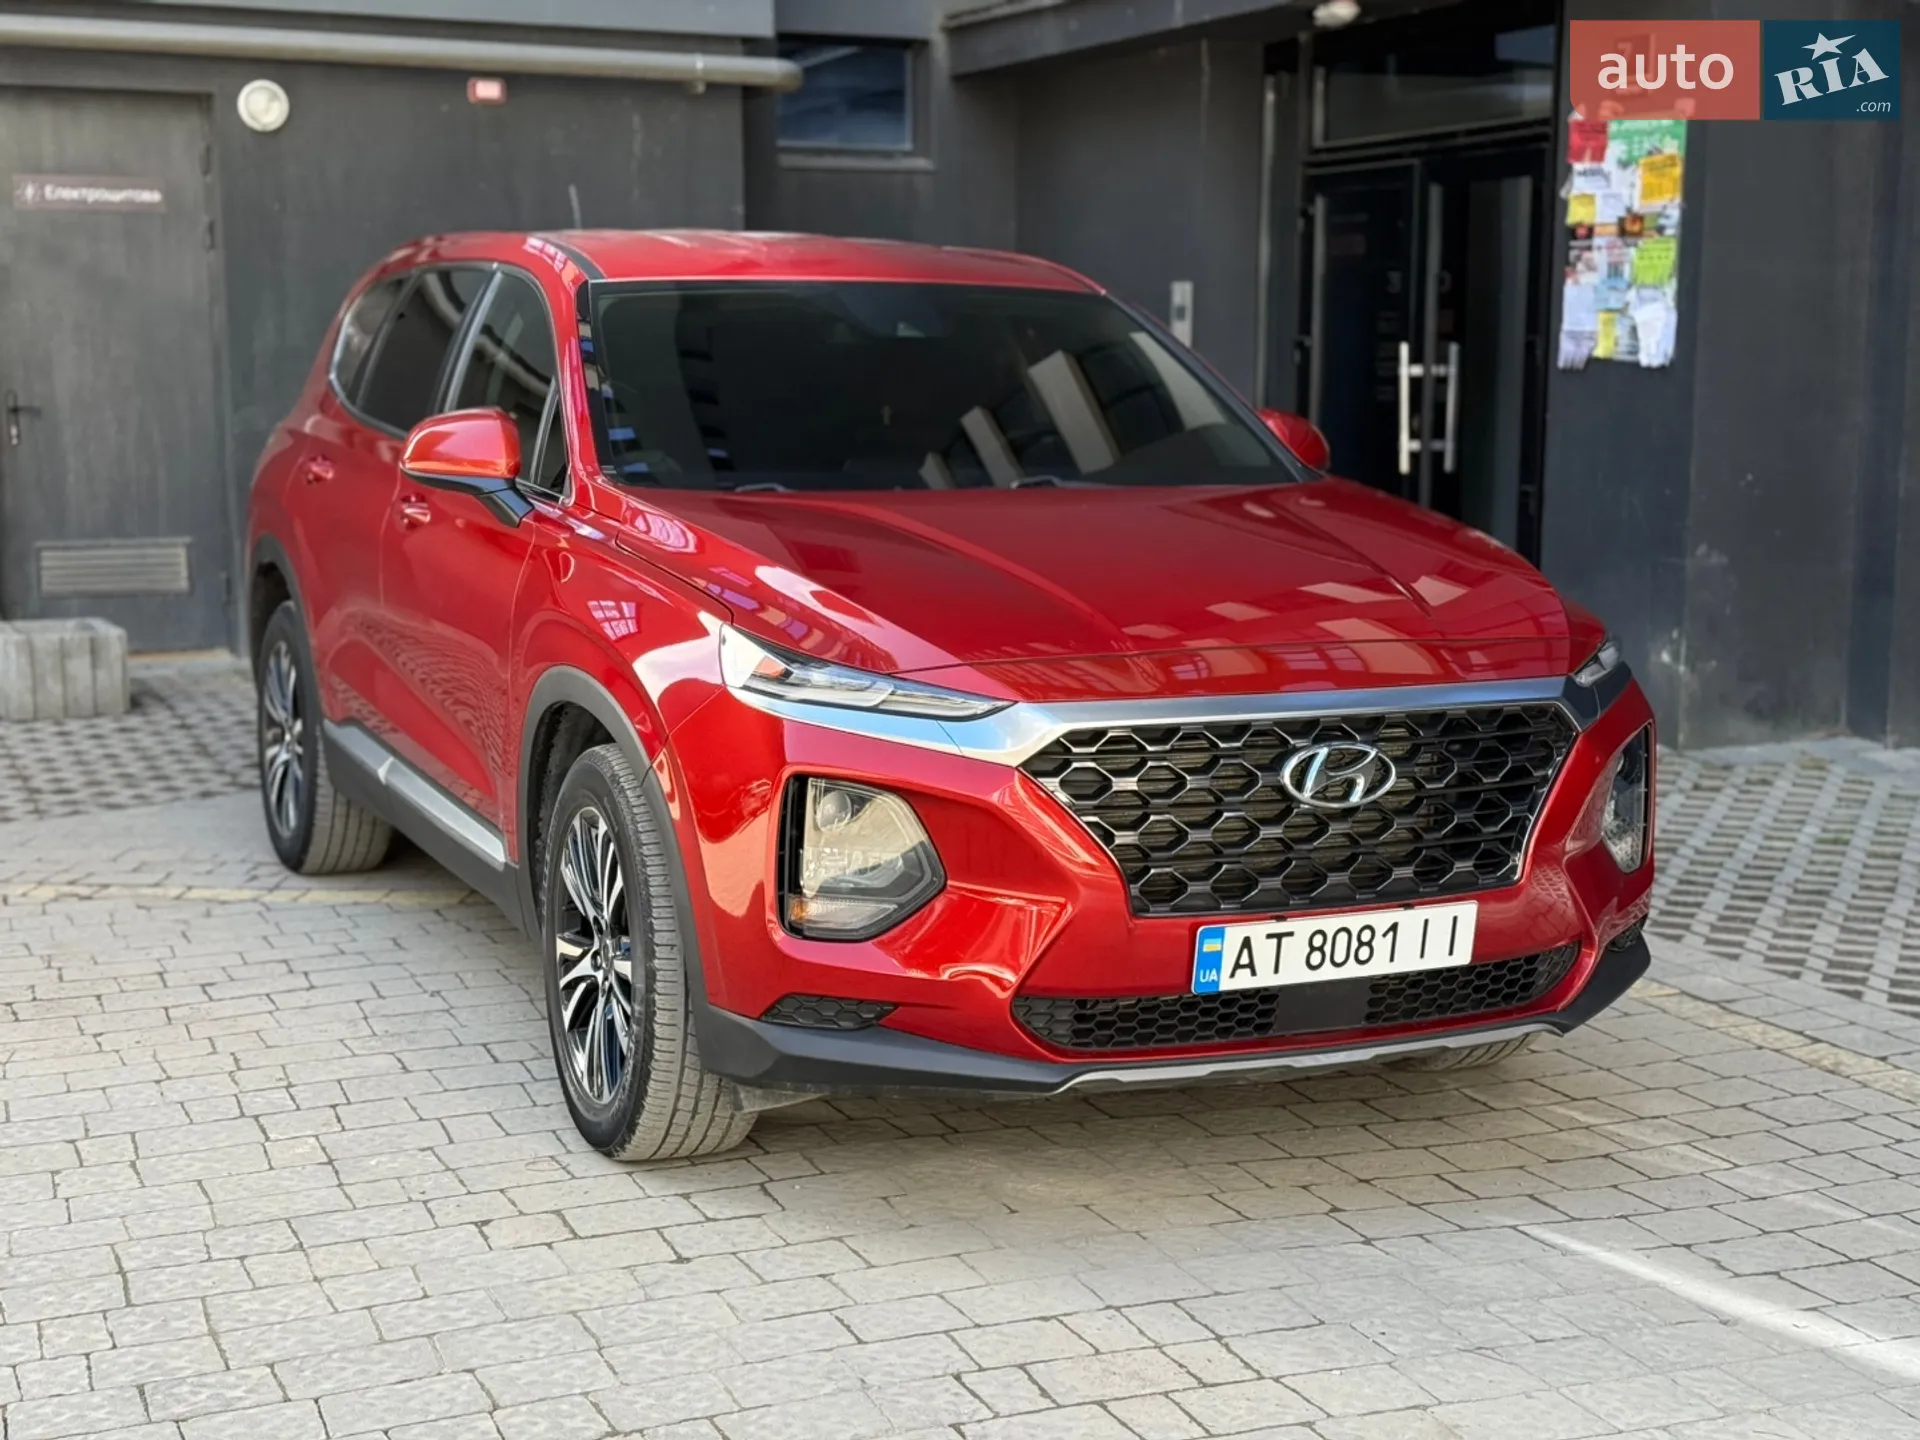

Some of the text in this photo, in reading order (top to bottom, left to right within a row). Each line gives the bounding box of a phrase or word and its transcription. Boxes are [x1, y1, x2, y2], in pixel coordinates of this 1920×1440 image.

[1228, 930, 1295, 979] AT
[1305, 921, 1400, 972] 8081
[1199, 967, 1219, 983] UA
